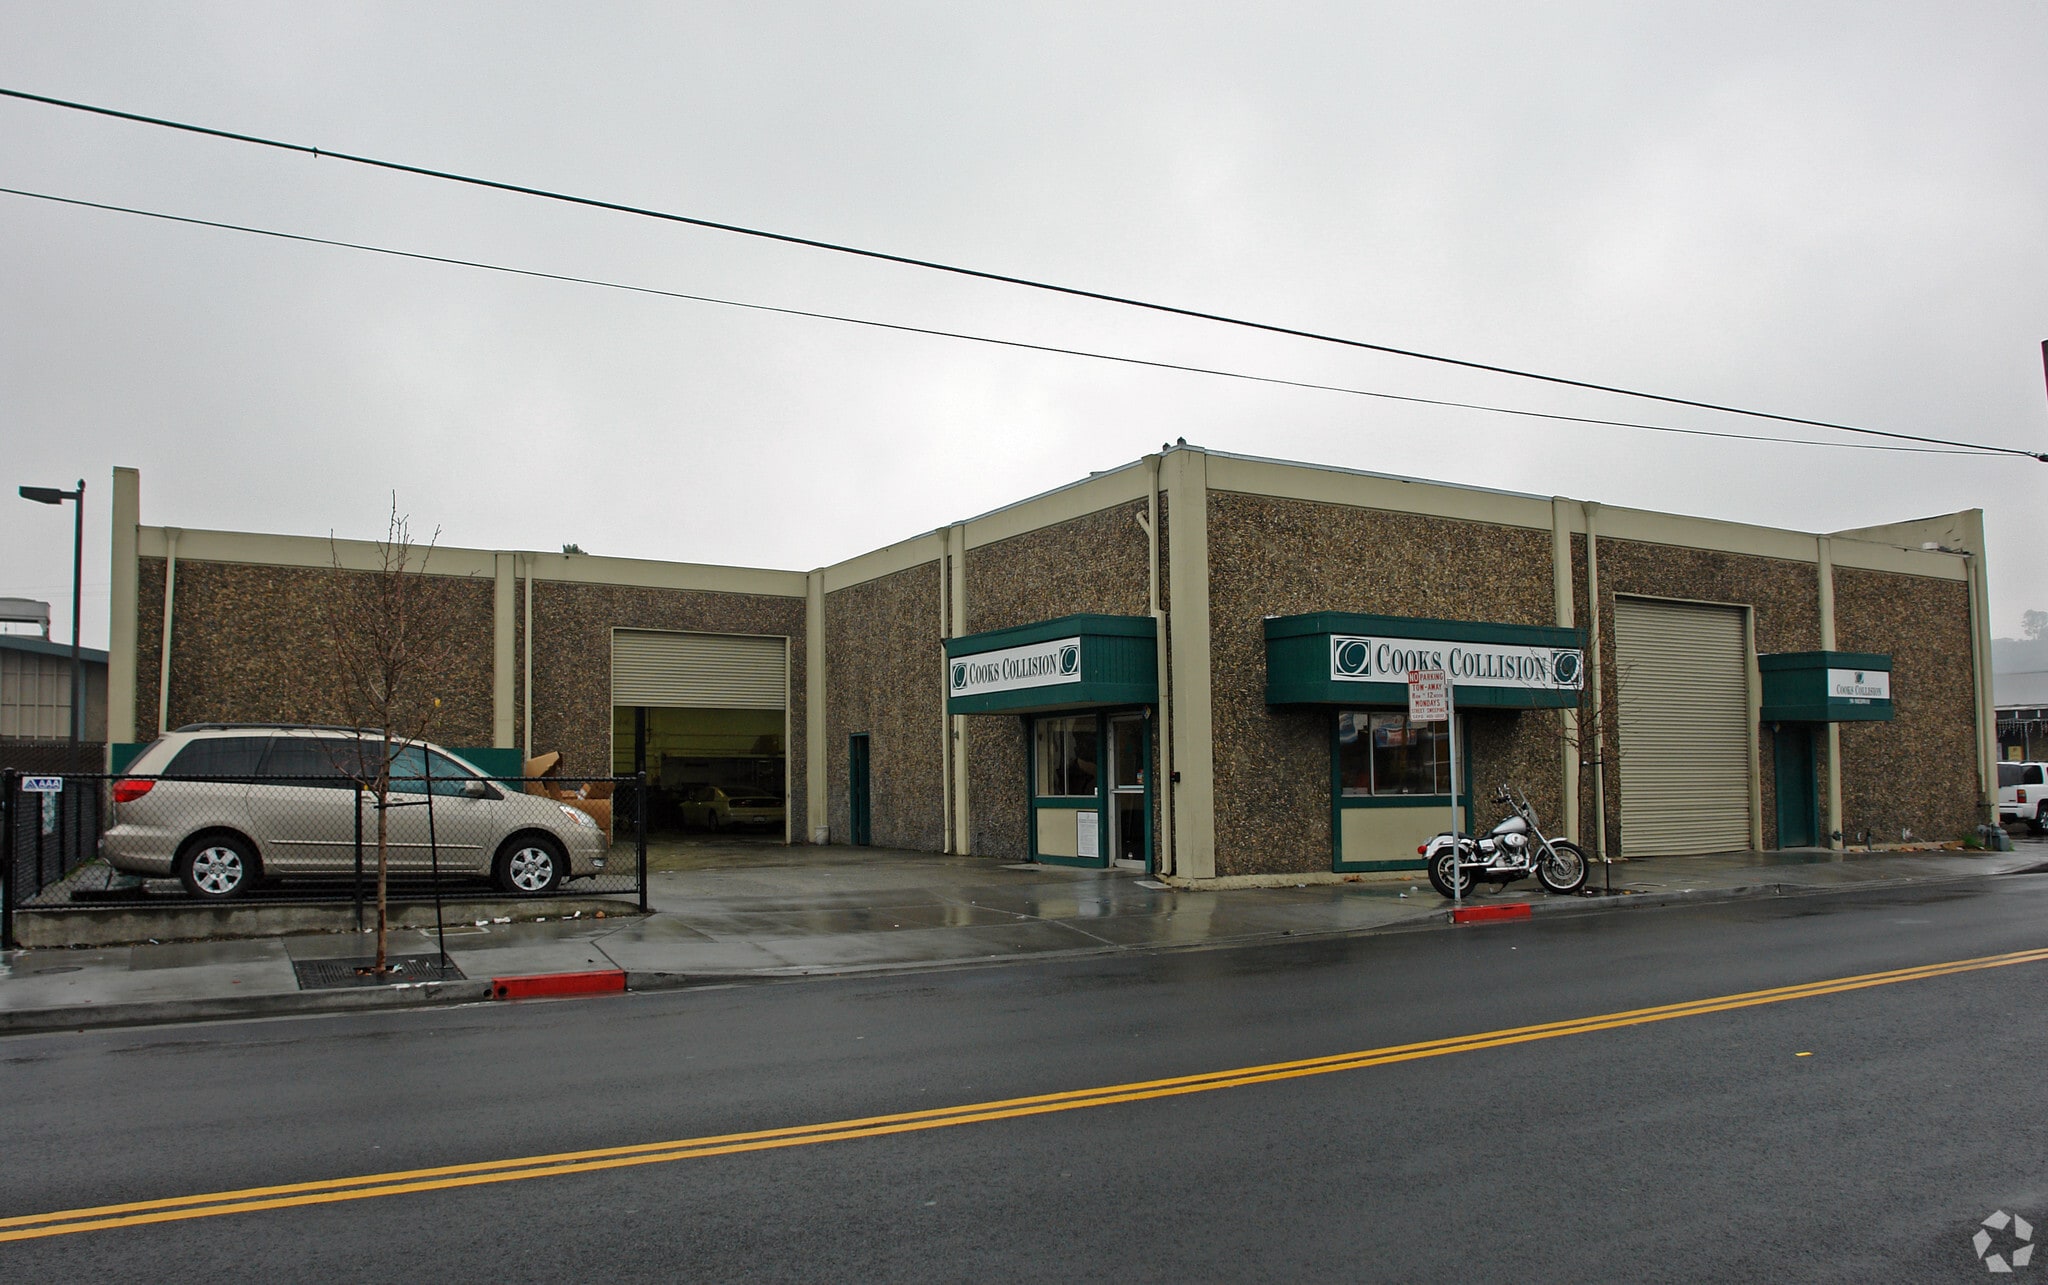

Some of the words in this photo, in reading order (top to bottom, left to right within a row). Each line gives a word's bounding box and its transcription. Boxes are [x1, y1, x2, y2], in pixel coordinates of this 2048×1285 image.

[1376, 643, 1441, 675] COOKS
[1448, 647, 1546, 681] COLLISION
[969, 663, 999, 684] COOKS
[1002, 653, 1057, 680] COLLISION
[1410, 672, 1419, 683] NO
[1420, 672, 1443, 681] PARKING
[1412, 683, 1442, 691] TOW-AWAY
[1836, 684, 1854, 696] COOKS
[1854, 685, 1882, 697] COLLISION
[1415, 699, 1441, 708] MONDAYS
[38, 779, 60, 789] AAA
